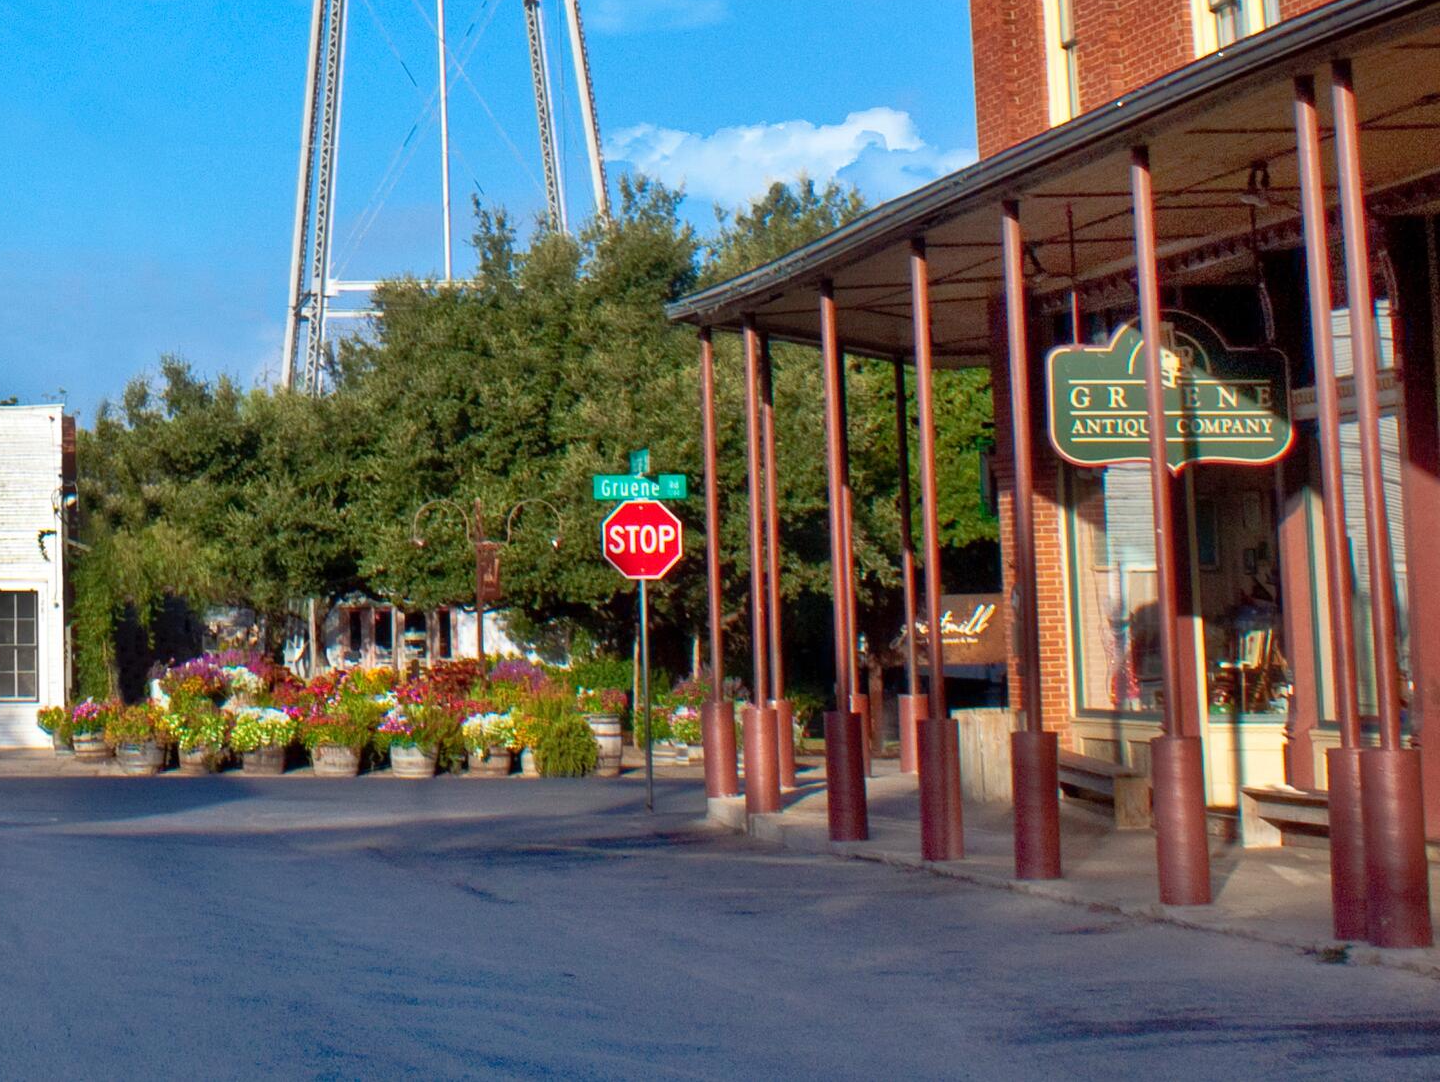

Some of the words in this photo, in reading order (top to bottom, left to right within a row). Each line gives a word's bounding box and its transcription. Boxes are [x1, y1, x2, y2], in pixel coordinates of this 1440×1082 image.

[1069, 386, 1272, 408] GRENE
[1072, 419, 1155, 437] ANTIQU
[1176, 419, 1273, 434] COMPANY
[601, 479, 660, 497] Gruene
[608, 524, 676, 554] STOP
